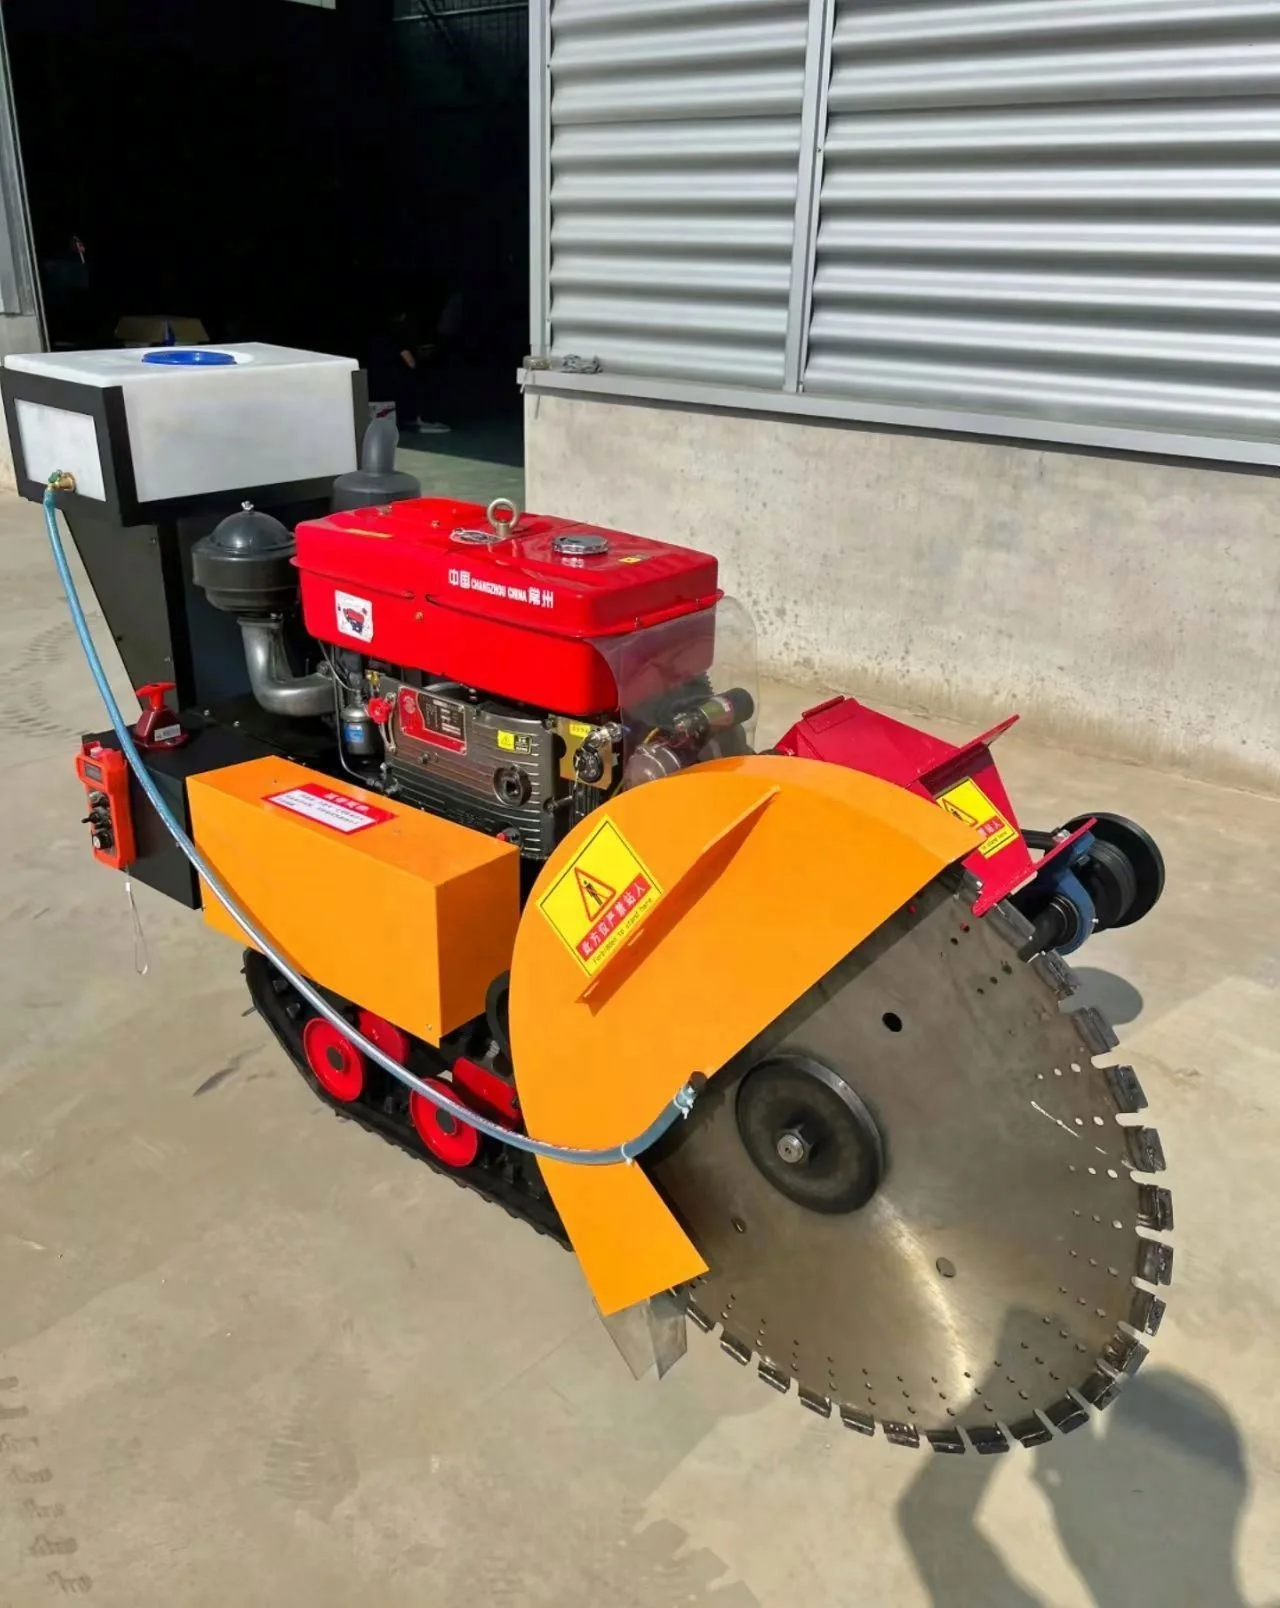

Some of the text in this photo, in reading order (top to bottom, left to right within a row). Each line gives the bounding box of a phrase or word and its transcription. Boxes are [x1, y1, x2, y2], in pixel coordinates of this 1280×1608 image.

[448, 568, 554, 609] 中国 CHANGZHOU CHINA 常州
